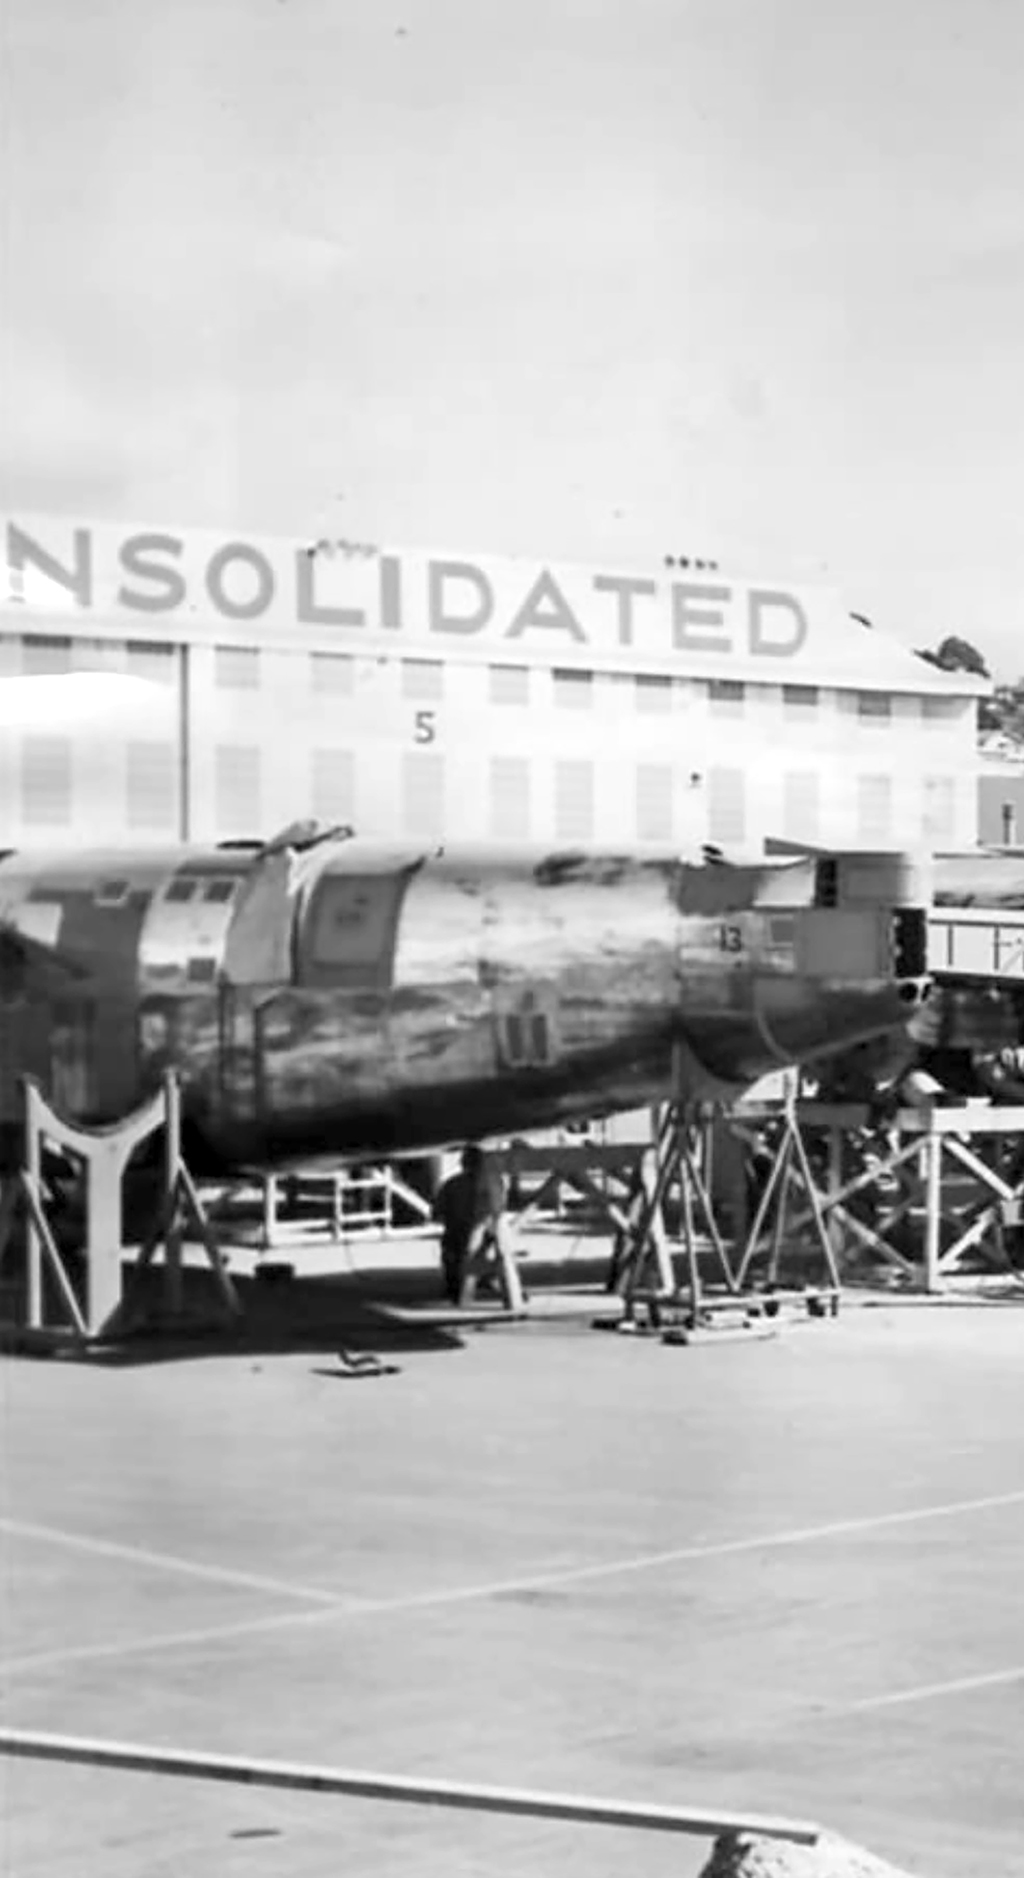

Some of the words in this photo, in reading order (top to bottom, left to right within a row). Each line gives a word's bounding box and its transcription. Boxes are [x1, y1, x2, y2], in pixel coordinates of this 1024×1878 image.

[6, 520, 808, 658] NSOLIDATED
[413, 710, 436, 744] 5
[719, 922, 742, 952] 13
